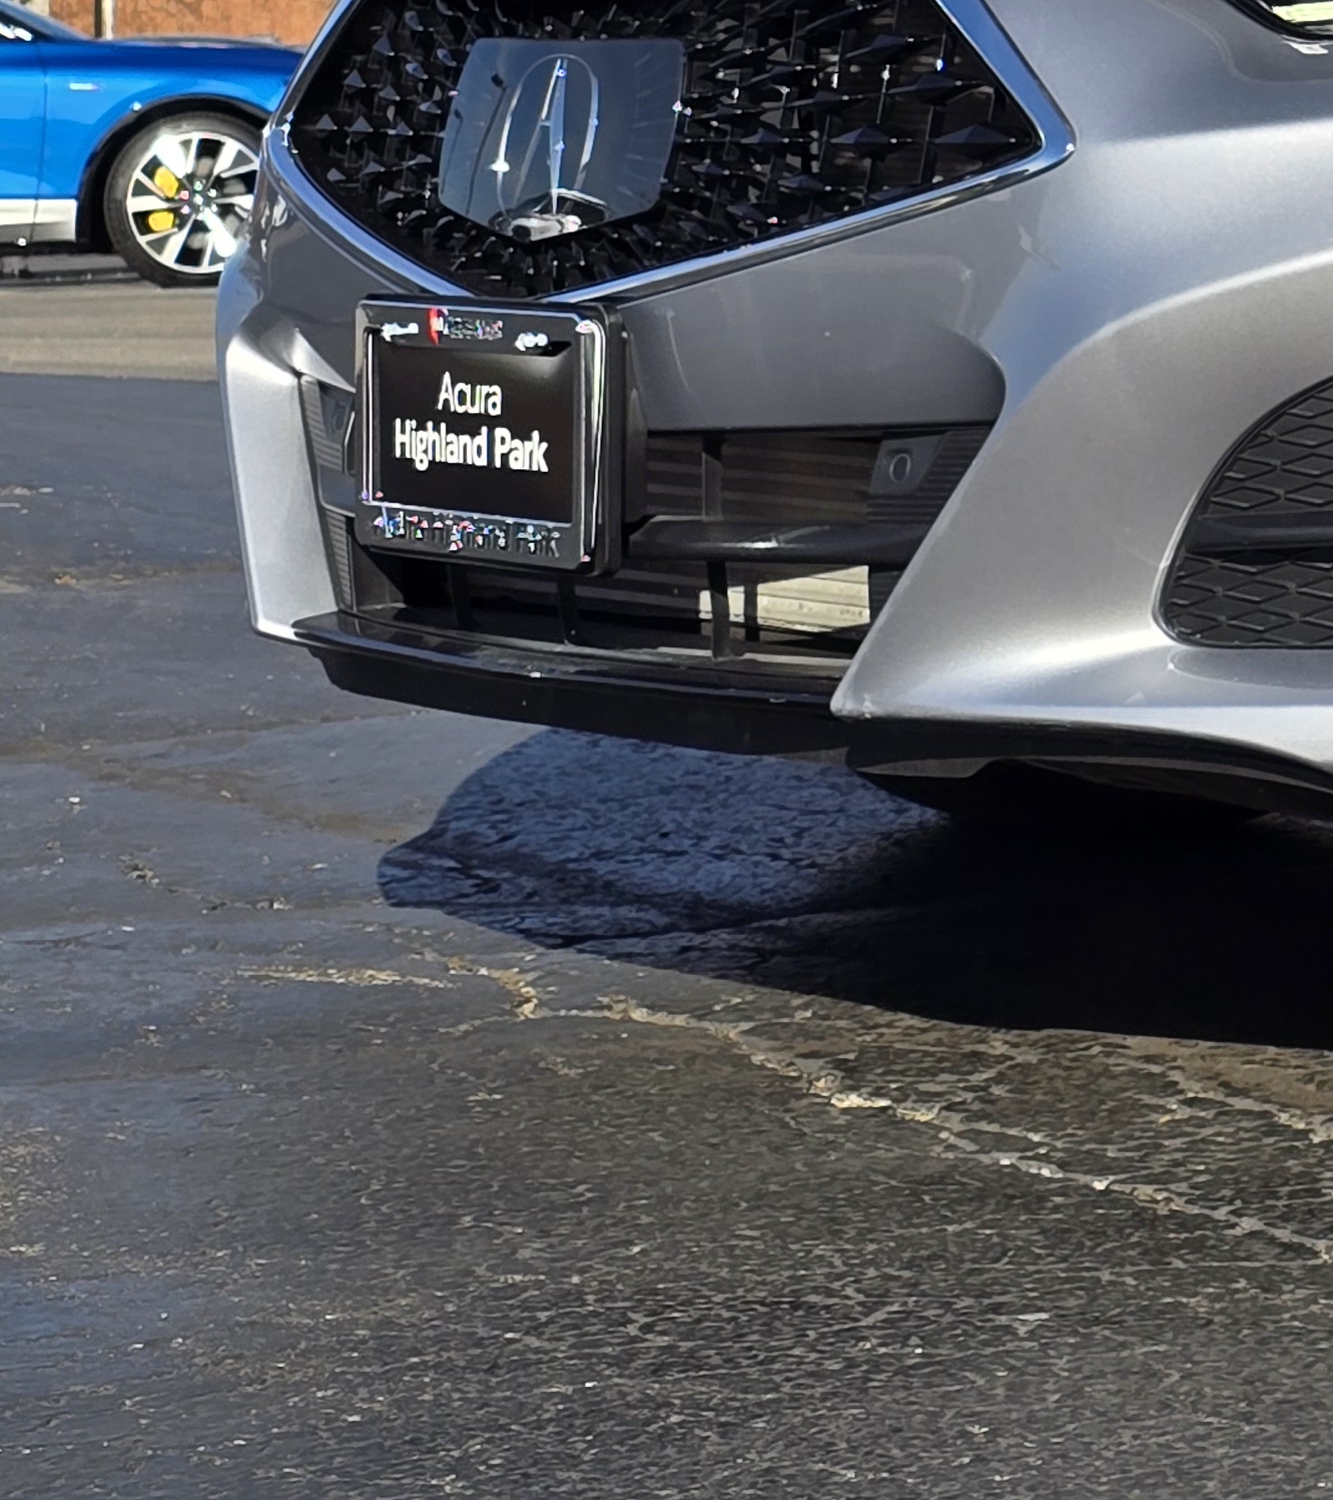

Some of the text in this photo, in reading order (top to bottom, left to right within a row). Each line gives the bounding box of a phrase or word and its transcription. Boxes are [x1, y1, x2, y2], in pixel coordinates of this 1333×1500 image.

[437, 371, 502, 416] Acura
[394, 418, 549, 472] Highland Park
